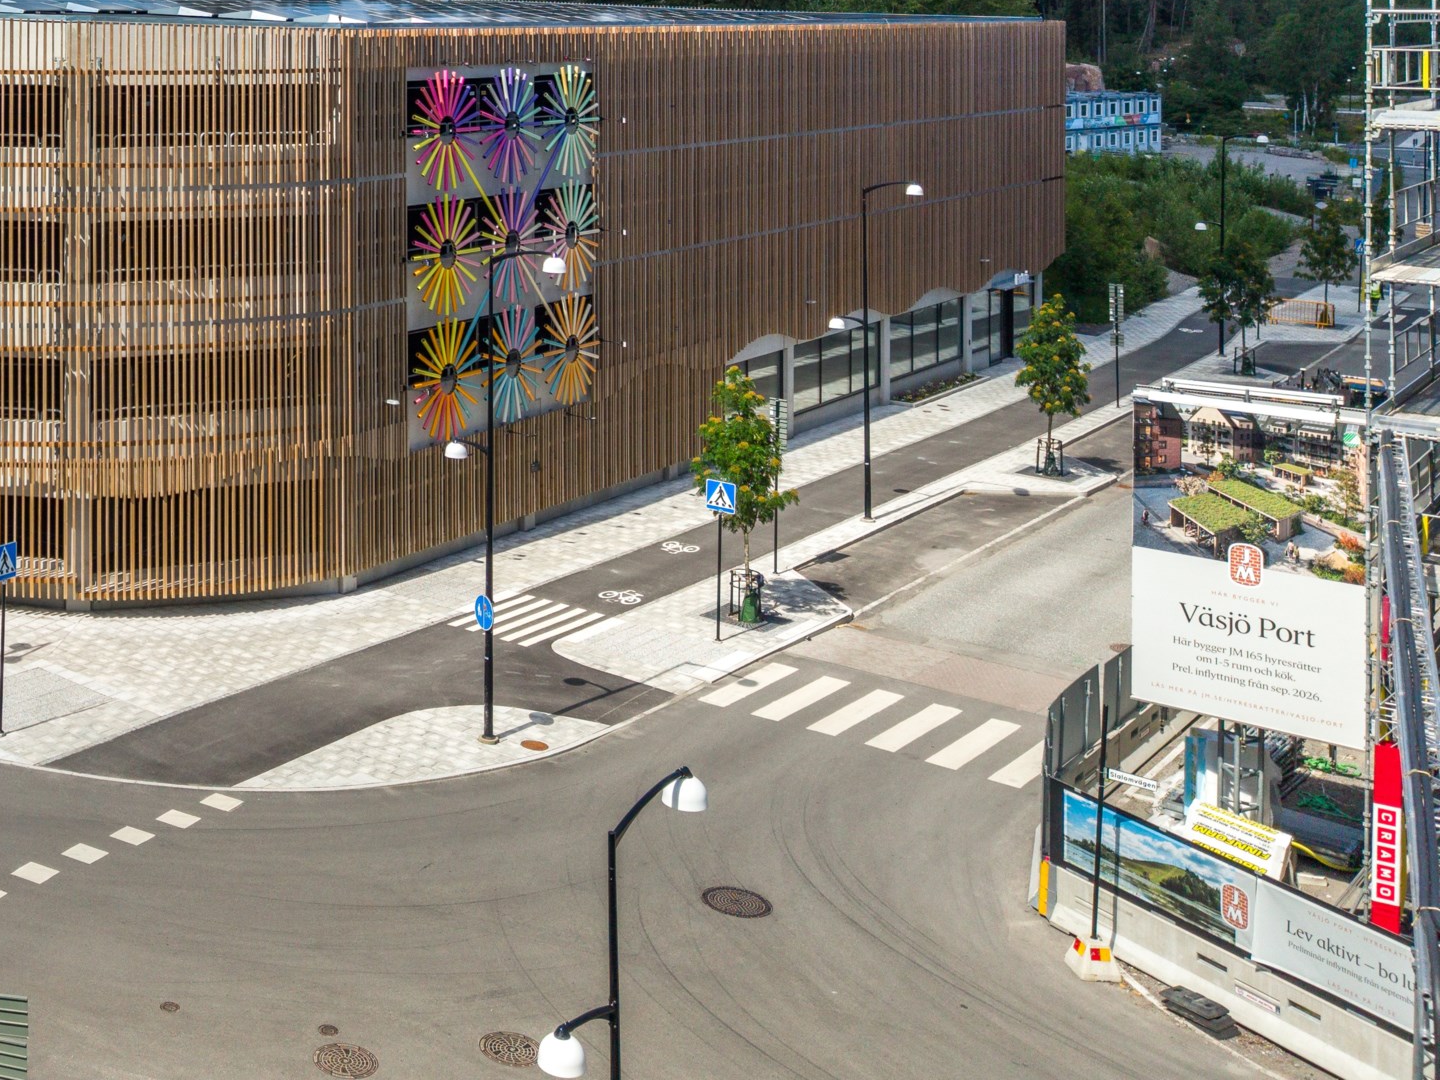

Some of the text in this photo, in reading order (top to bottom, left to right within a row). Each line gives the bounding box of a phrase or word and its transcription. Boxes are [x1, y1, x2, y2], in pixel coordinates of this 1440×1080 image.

[1178, 602, 1316, 648] Väsjö Port
[1172, 635, 1322, 674] Här bygger JM 165 hyresrätter
[1196, 654, 1297, 682] om 1-5 rum och kök.
[1172, 662, 1323, 703] Prel. inflyttning från sep. 2026.
[1110, 771, 1156, 789] Slalomvägen
[1192, 823, 1271, 861] FINNFORM
[1379, 811, 1393, 898] CRAMO
[1286, 919, 1314, 943] Lev
[1316, 935, 1361, 967] aktivt
[1378, 962, 1399, 984] bo
[1288, 940, 1325, 963] Preliminär
[1326, 957, 1363, 983] inflyttning
[1364, 975, 1380, 989] från
